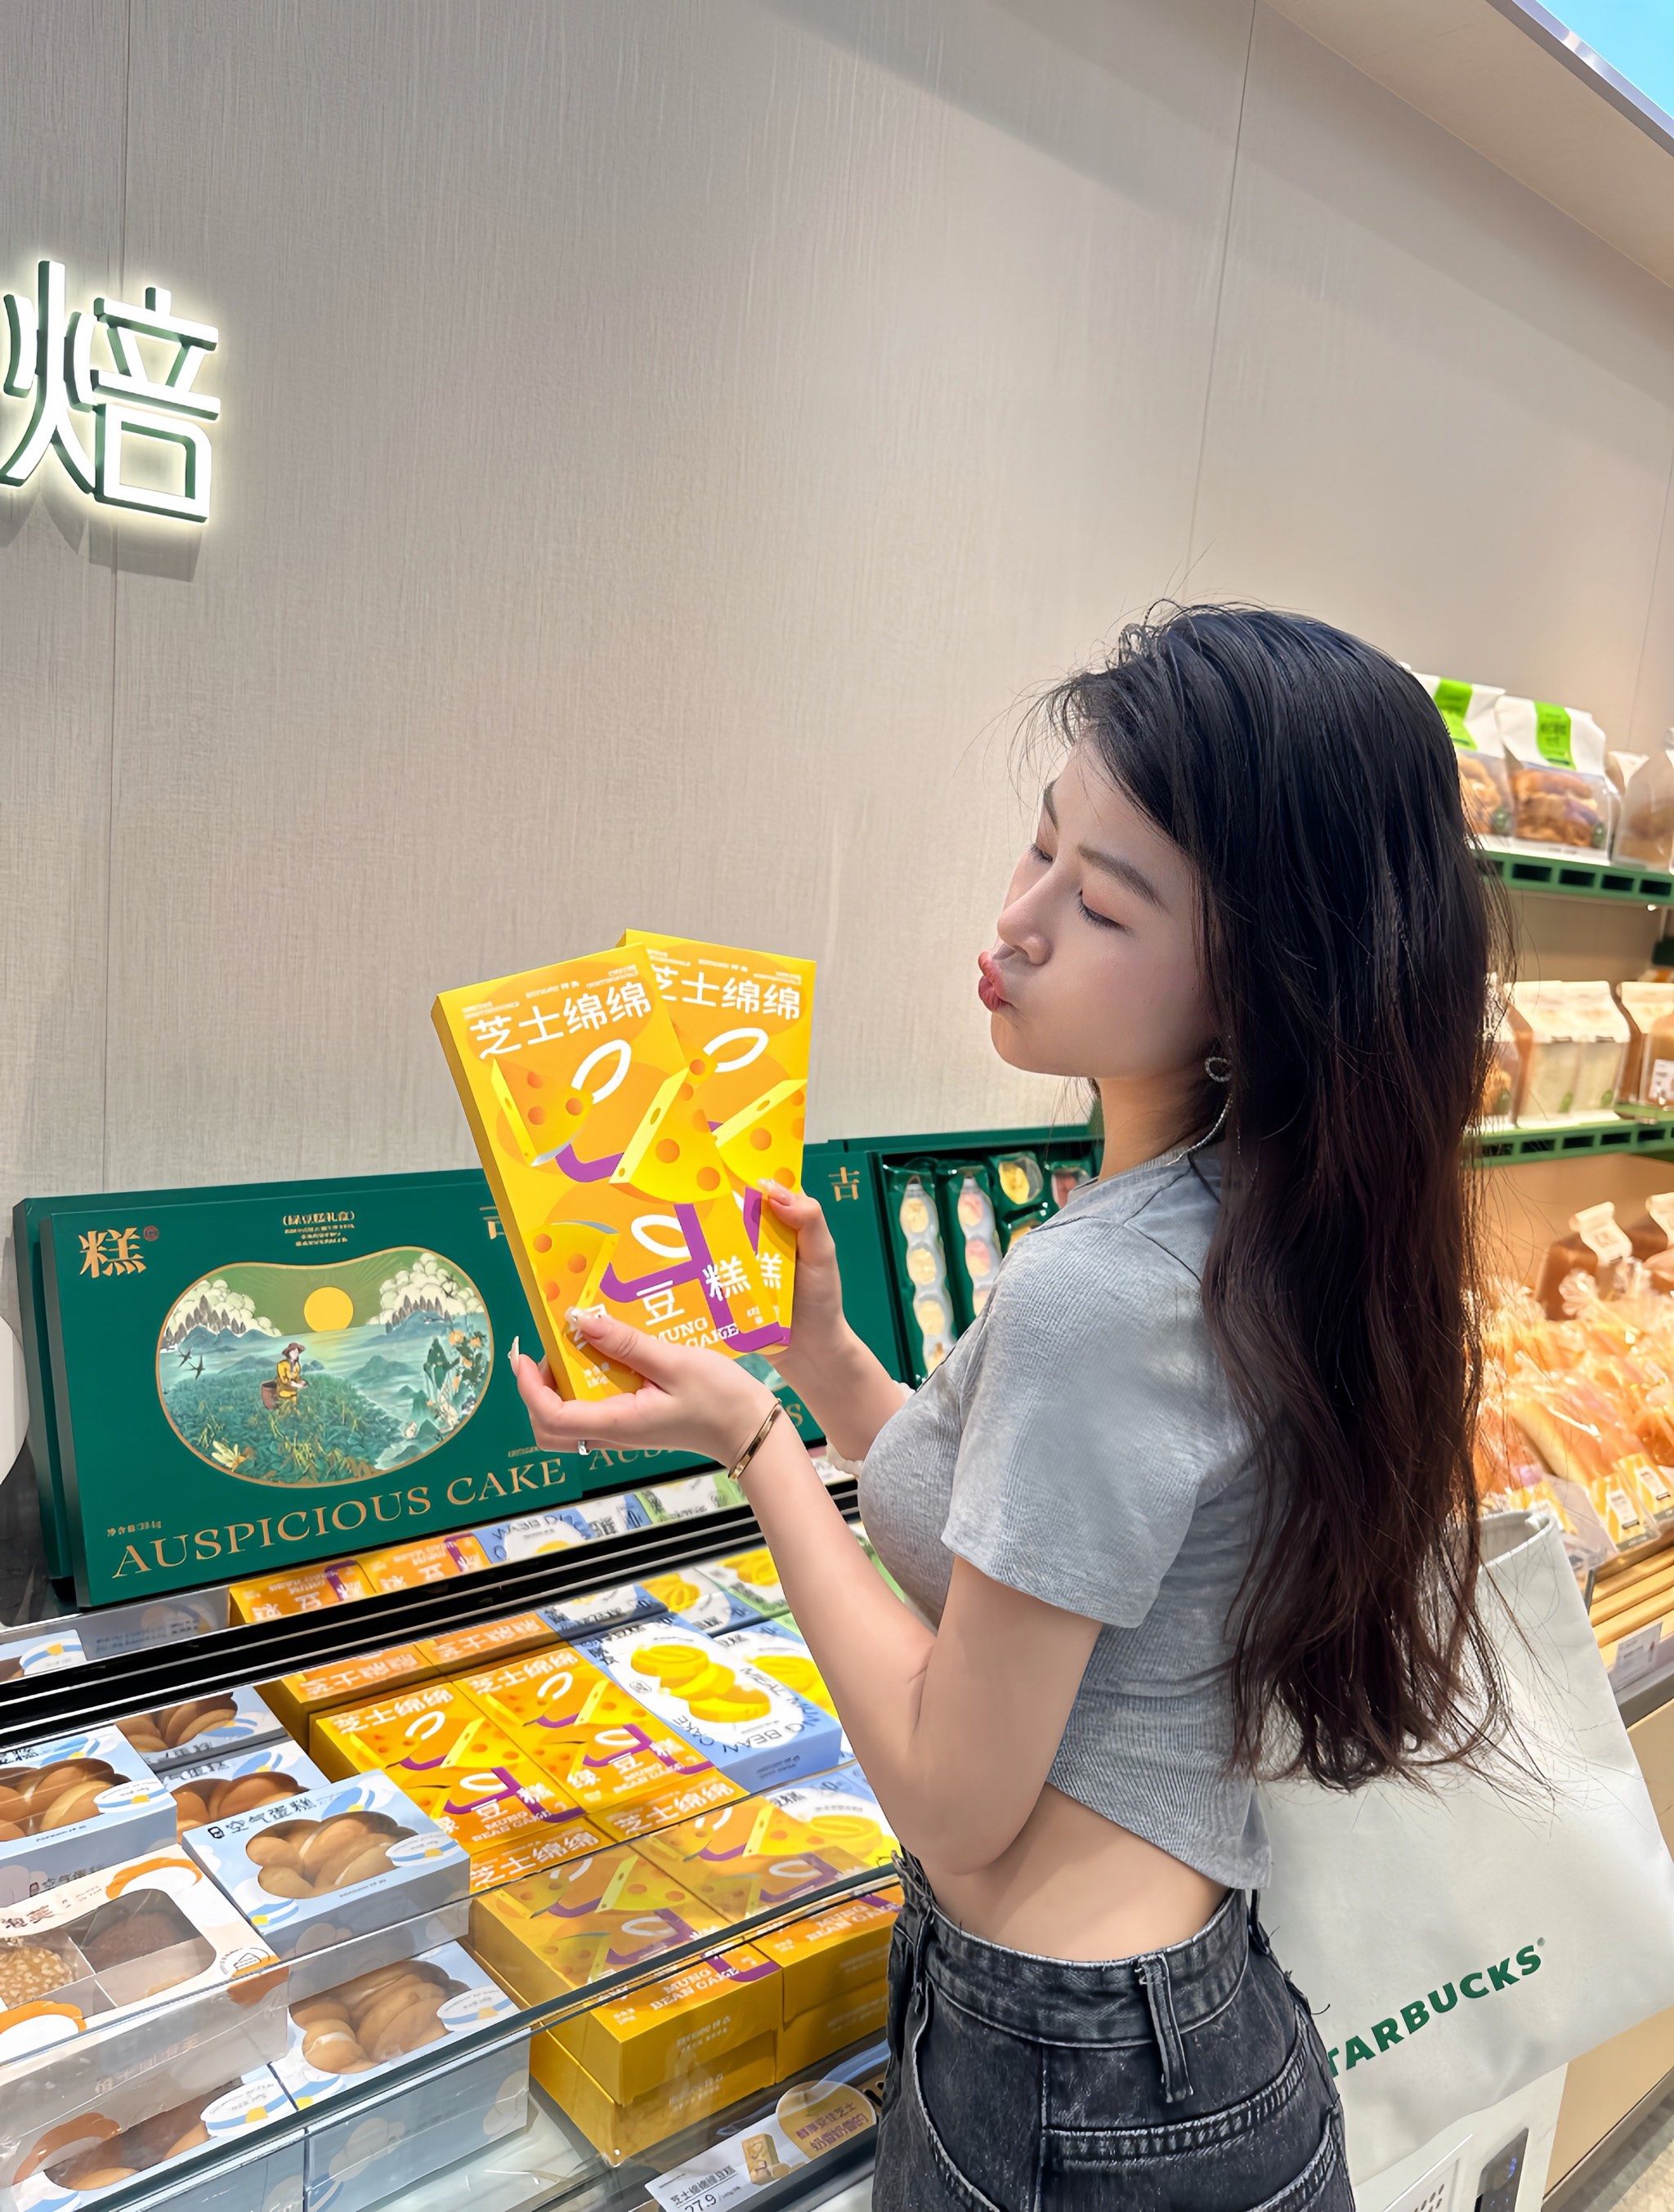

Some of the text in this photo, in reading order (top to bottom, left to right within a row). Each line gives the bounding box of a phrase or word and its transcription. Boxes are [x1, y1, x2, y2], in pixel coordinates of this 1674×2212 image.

[0, 260, 221, 524] 焙
[469, 981, 651, 1059] 芝士绵绵
[79, 1227, 146, 1279] 糕
[112, 1458, 566, 1579] AUSPICIOUS CAKE
[468, 1651, 579, 1695] 芝士绵绵
[333, 1688, 454, 1734] 芝士绵绵
[672, 1714, 716, 1746] CAKE
[723, 1728, 782, 1754] BEAN
[614, 1781, 735, 1834] 芝士绵绵
[471, 1830, 599, 1886] 芝士绵绵
[1327, 1945, 1542, 2078] TARBUCKS
